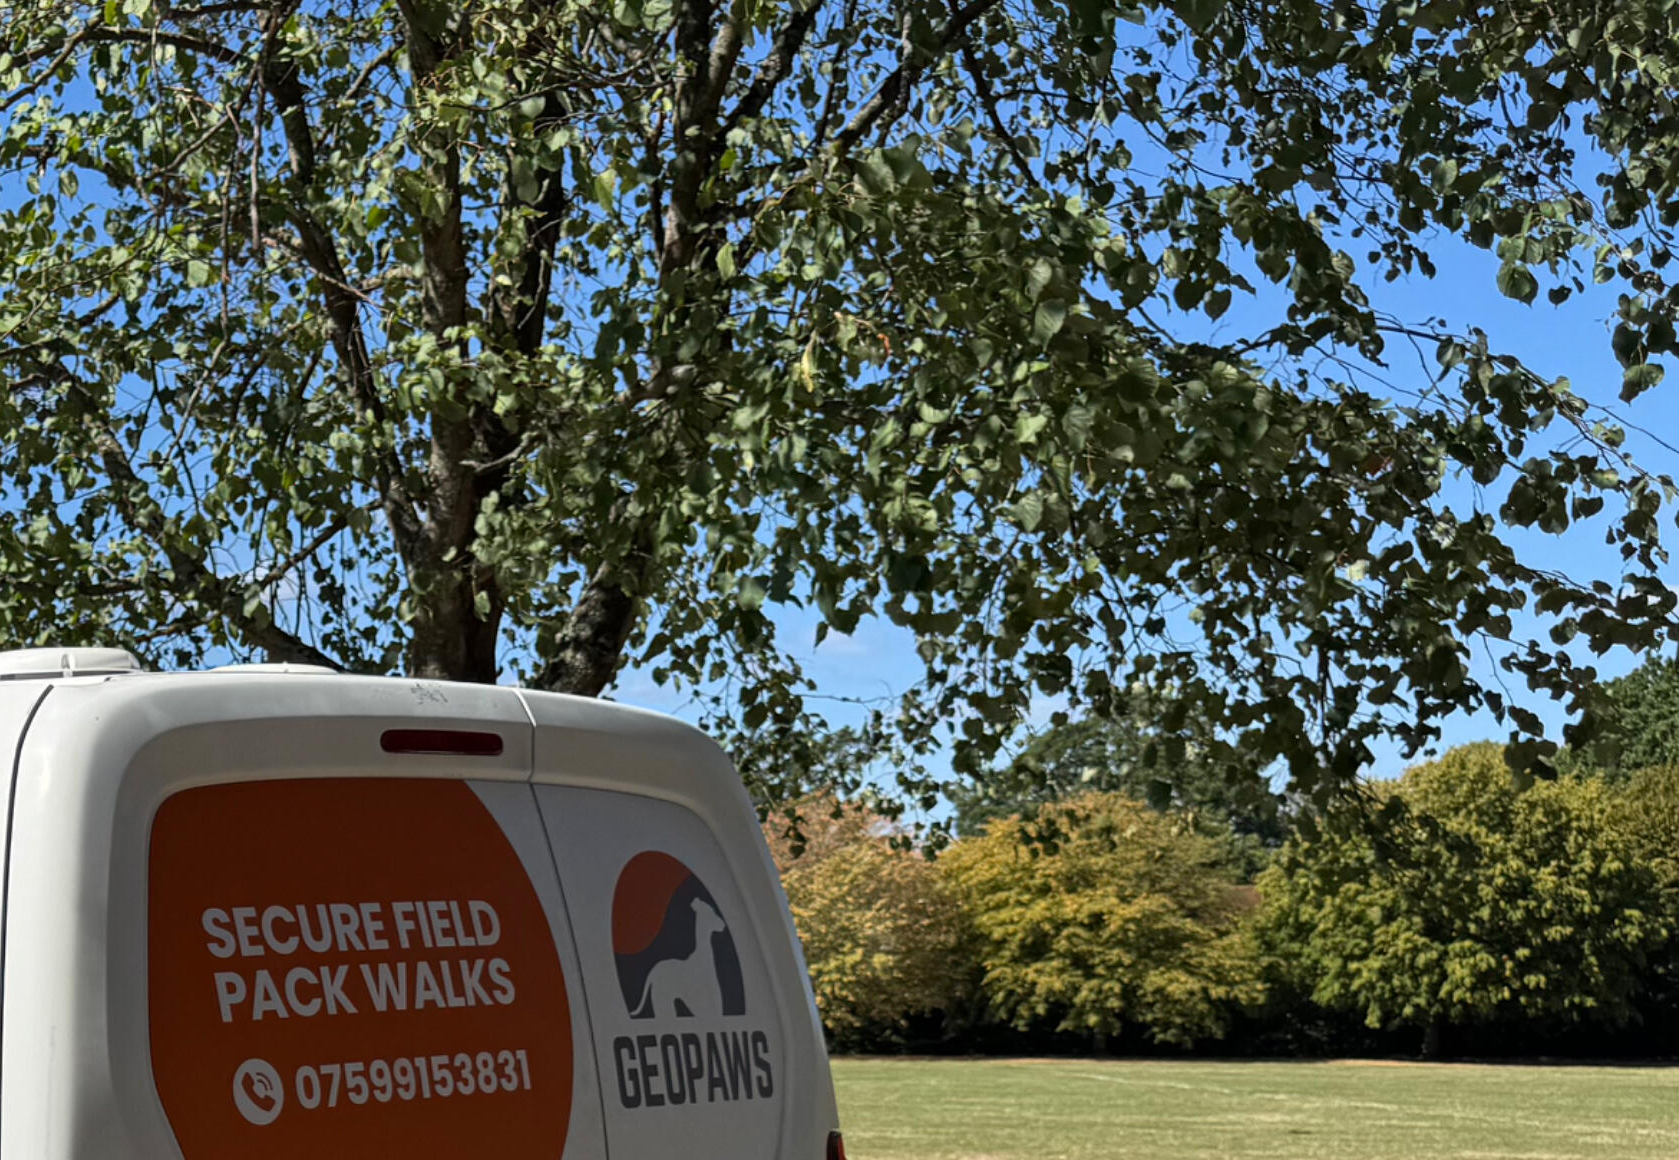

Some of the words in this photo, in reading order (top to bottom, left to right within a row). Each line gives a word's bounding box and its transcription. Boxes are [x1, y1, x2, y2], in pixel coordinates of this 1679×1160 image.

[201, 903, 389, 958] SECURE
[391, 900, 501, 949] FIELD
[213, 967, 357, 1023] PACK
[360, 958, 516, 1012] WALKS
[295, 1049, 532, 1110] 07599153831
[612, 1030, 774, 1109] GEOPAWS
